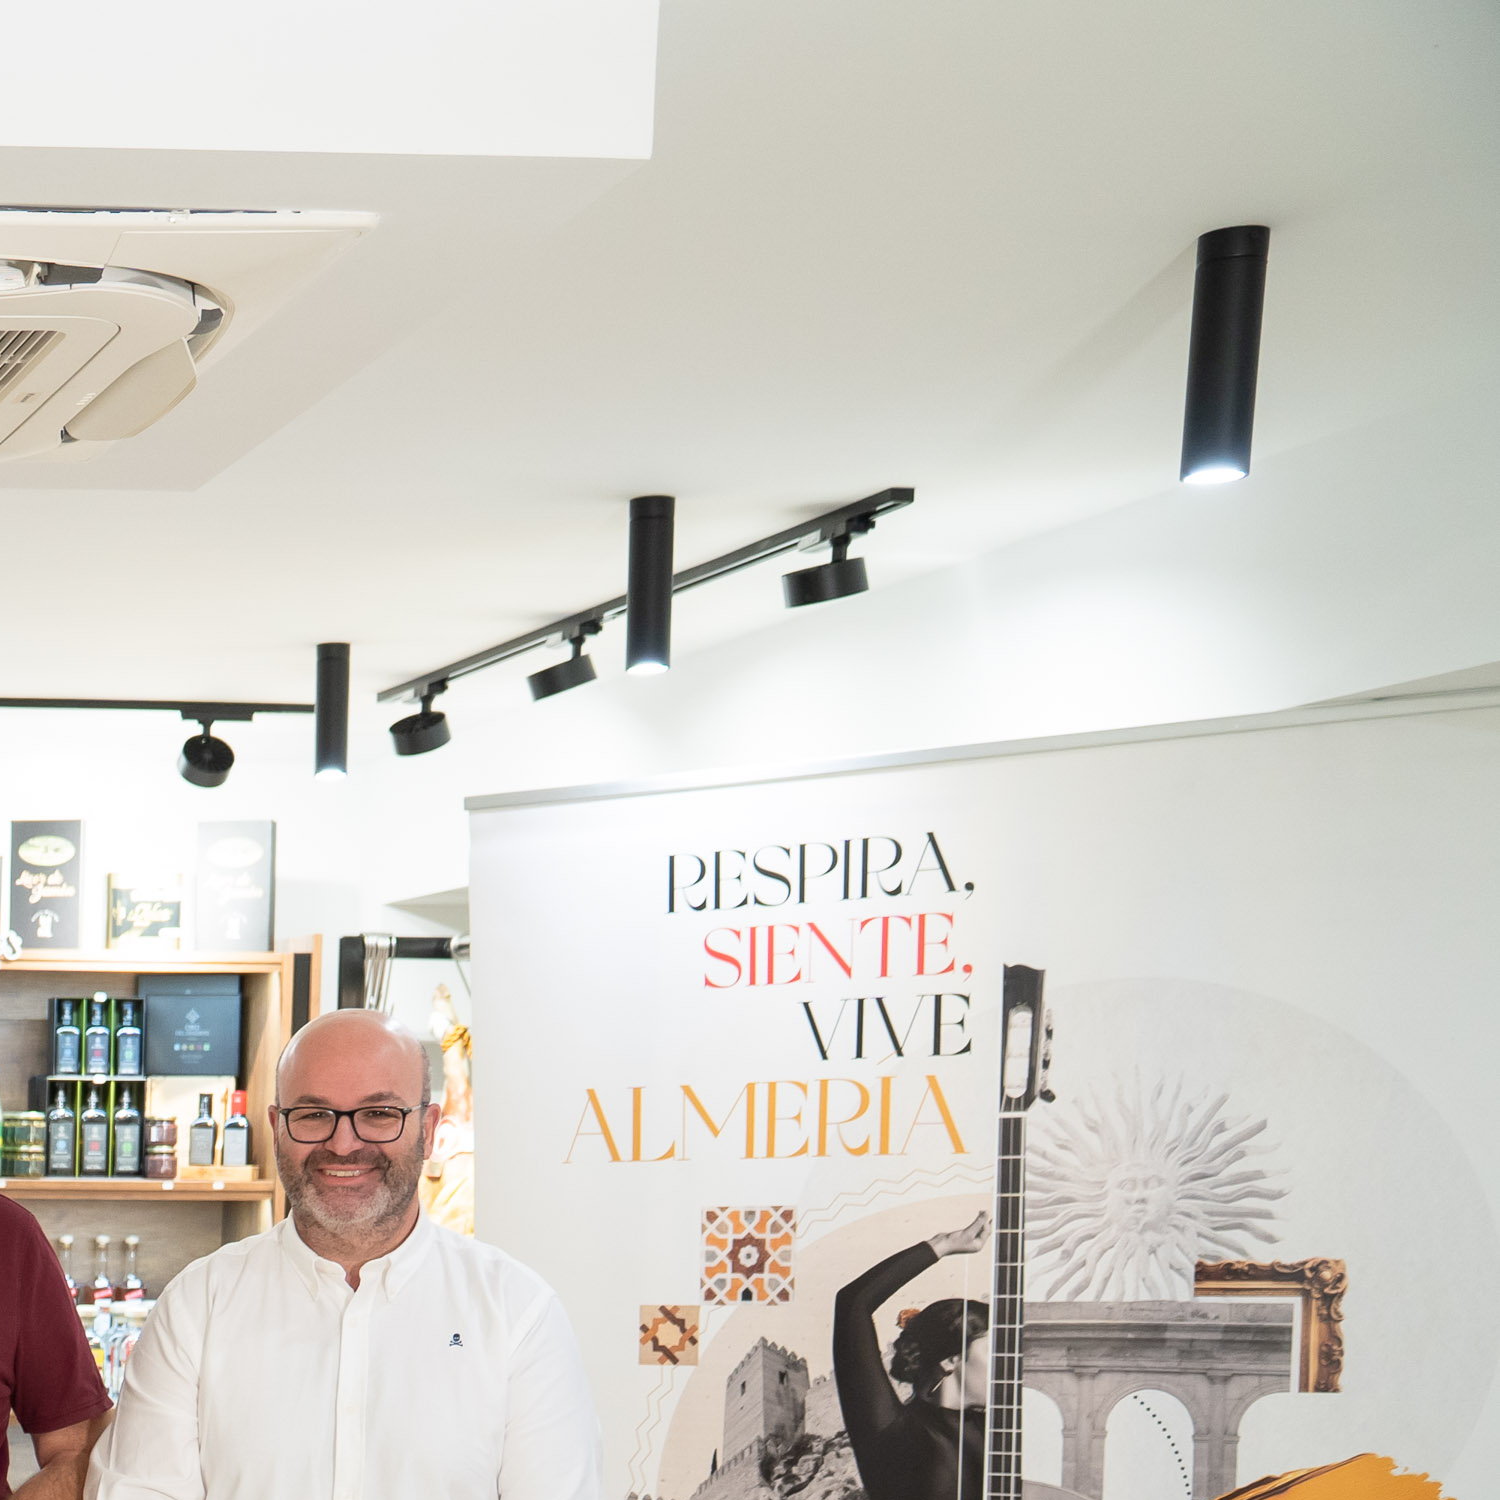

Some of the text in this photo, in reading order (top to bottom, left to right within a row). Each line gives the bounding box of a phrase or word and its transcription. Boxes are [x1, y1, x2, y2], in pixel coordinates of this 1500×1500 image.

[666, 831, 976, 913] RESPIRA,
[702, 911, 976, 989] SIENTE,
[798, 993, 973, 1061] VIVE
[562, 1050, 971, 1165] ALMERÍA
